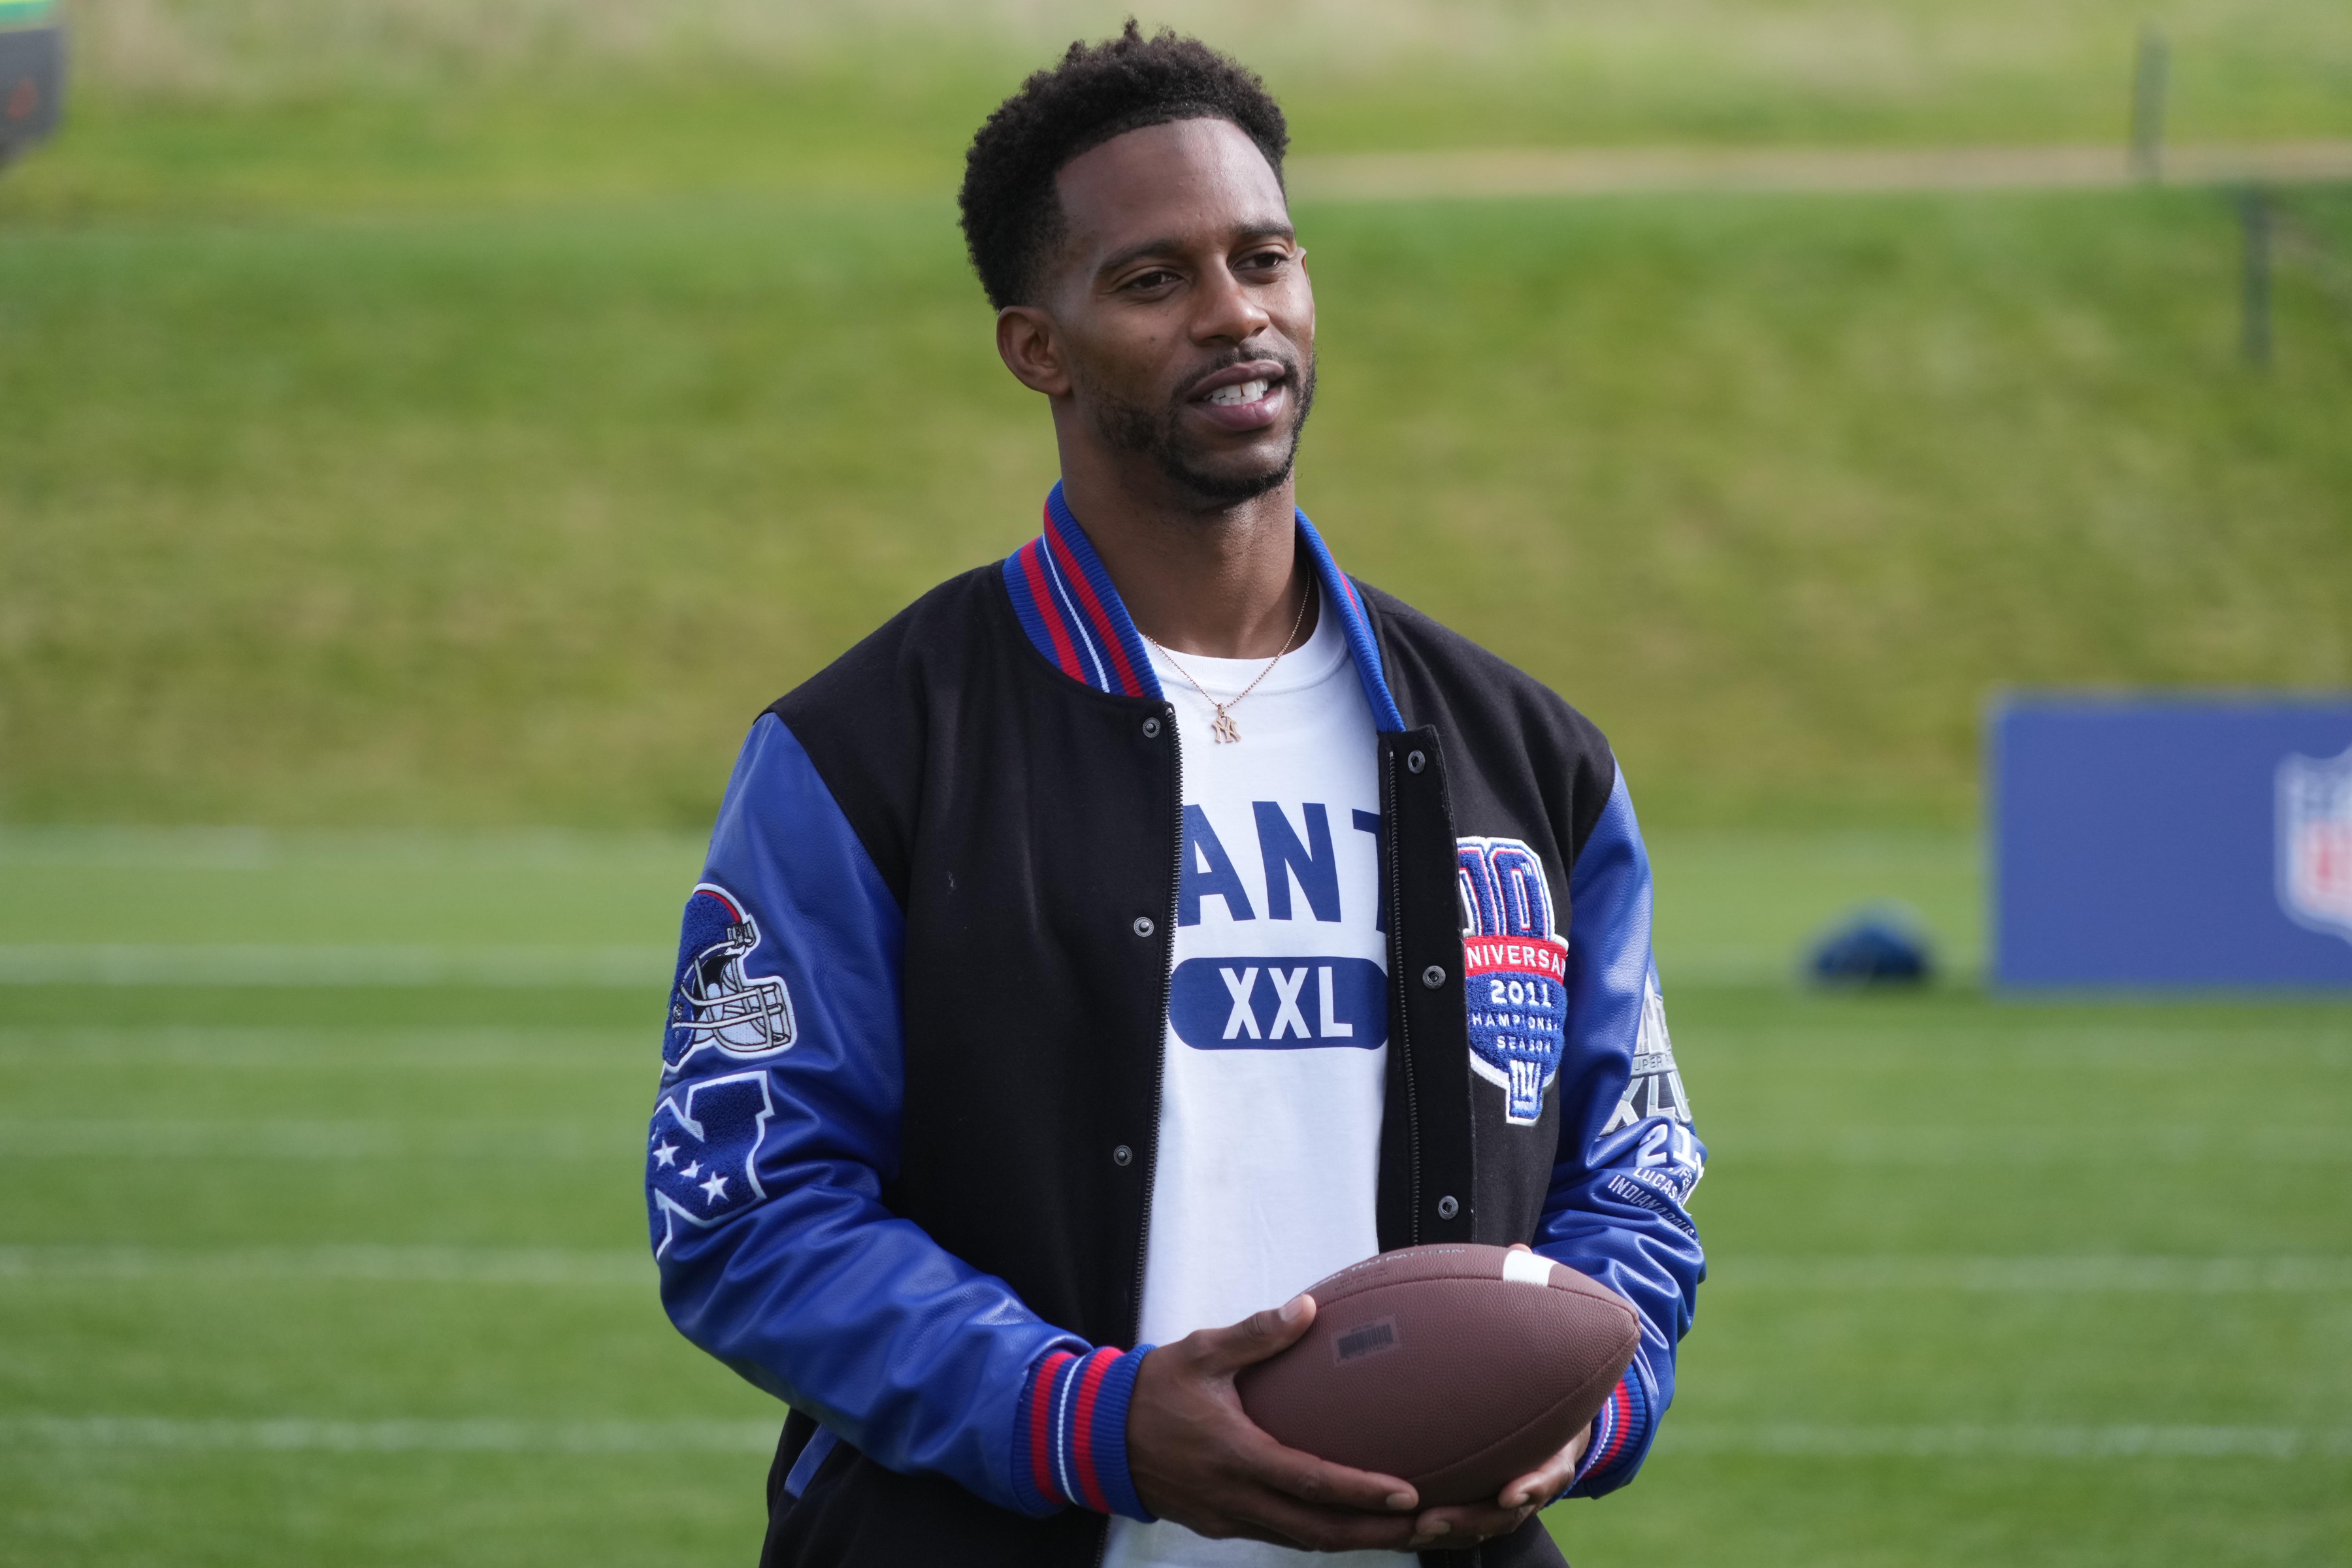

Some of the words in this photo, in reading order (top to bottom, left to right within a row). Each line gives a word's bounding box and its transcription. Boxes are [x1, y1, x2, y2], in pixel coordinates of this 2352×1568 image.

[1219, 966, 1353, 1040] XXL
[1490, 979, 1552, 1008] 2011
[1467, 1012, 1558, 1032] HAMPIONS
[1497, 1035, 1551, 1053] SEASON
[1633, 1167, 1678, 1200] LUCAS
